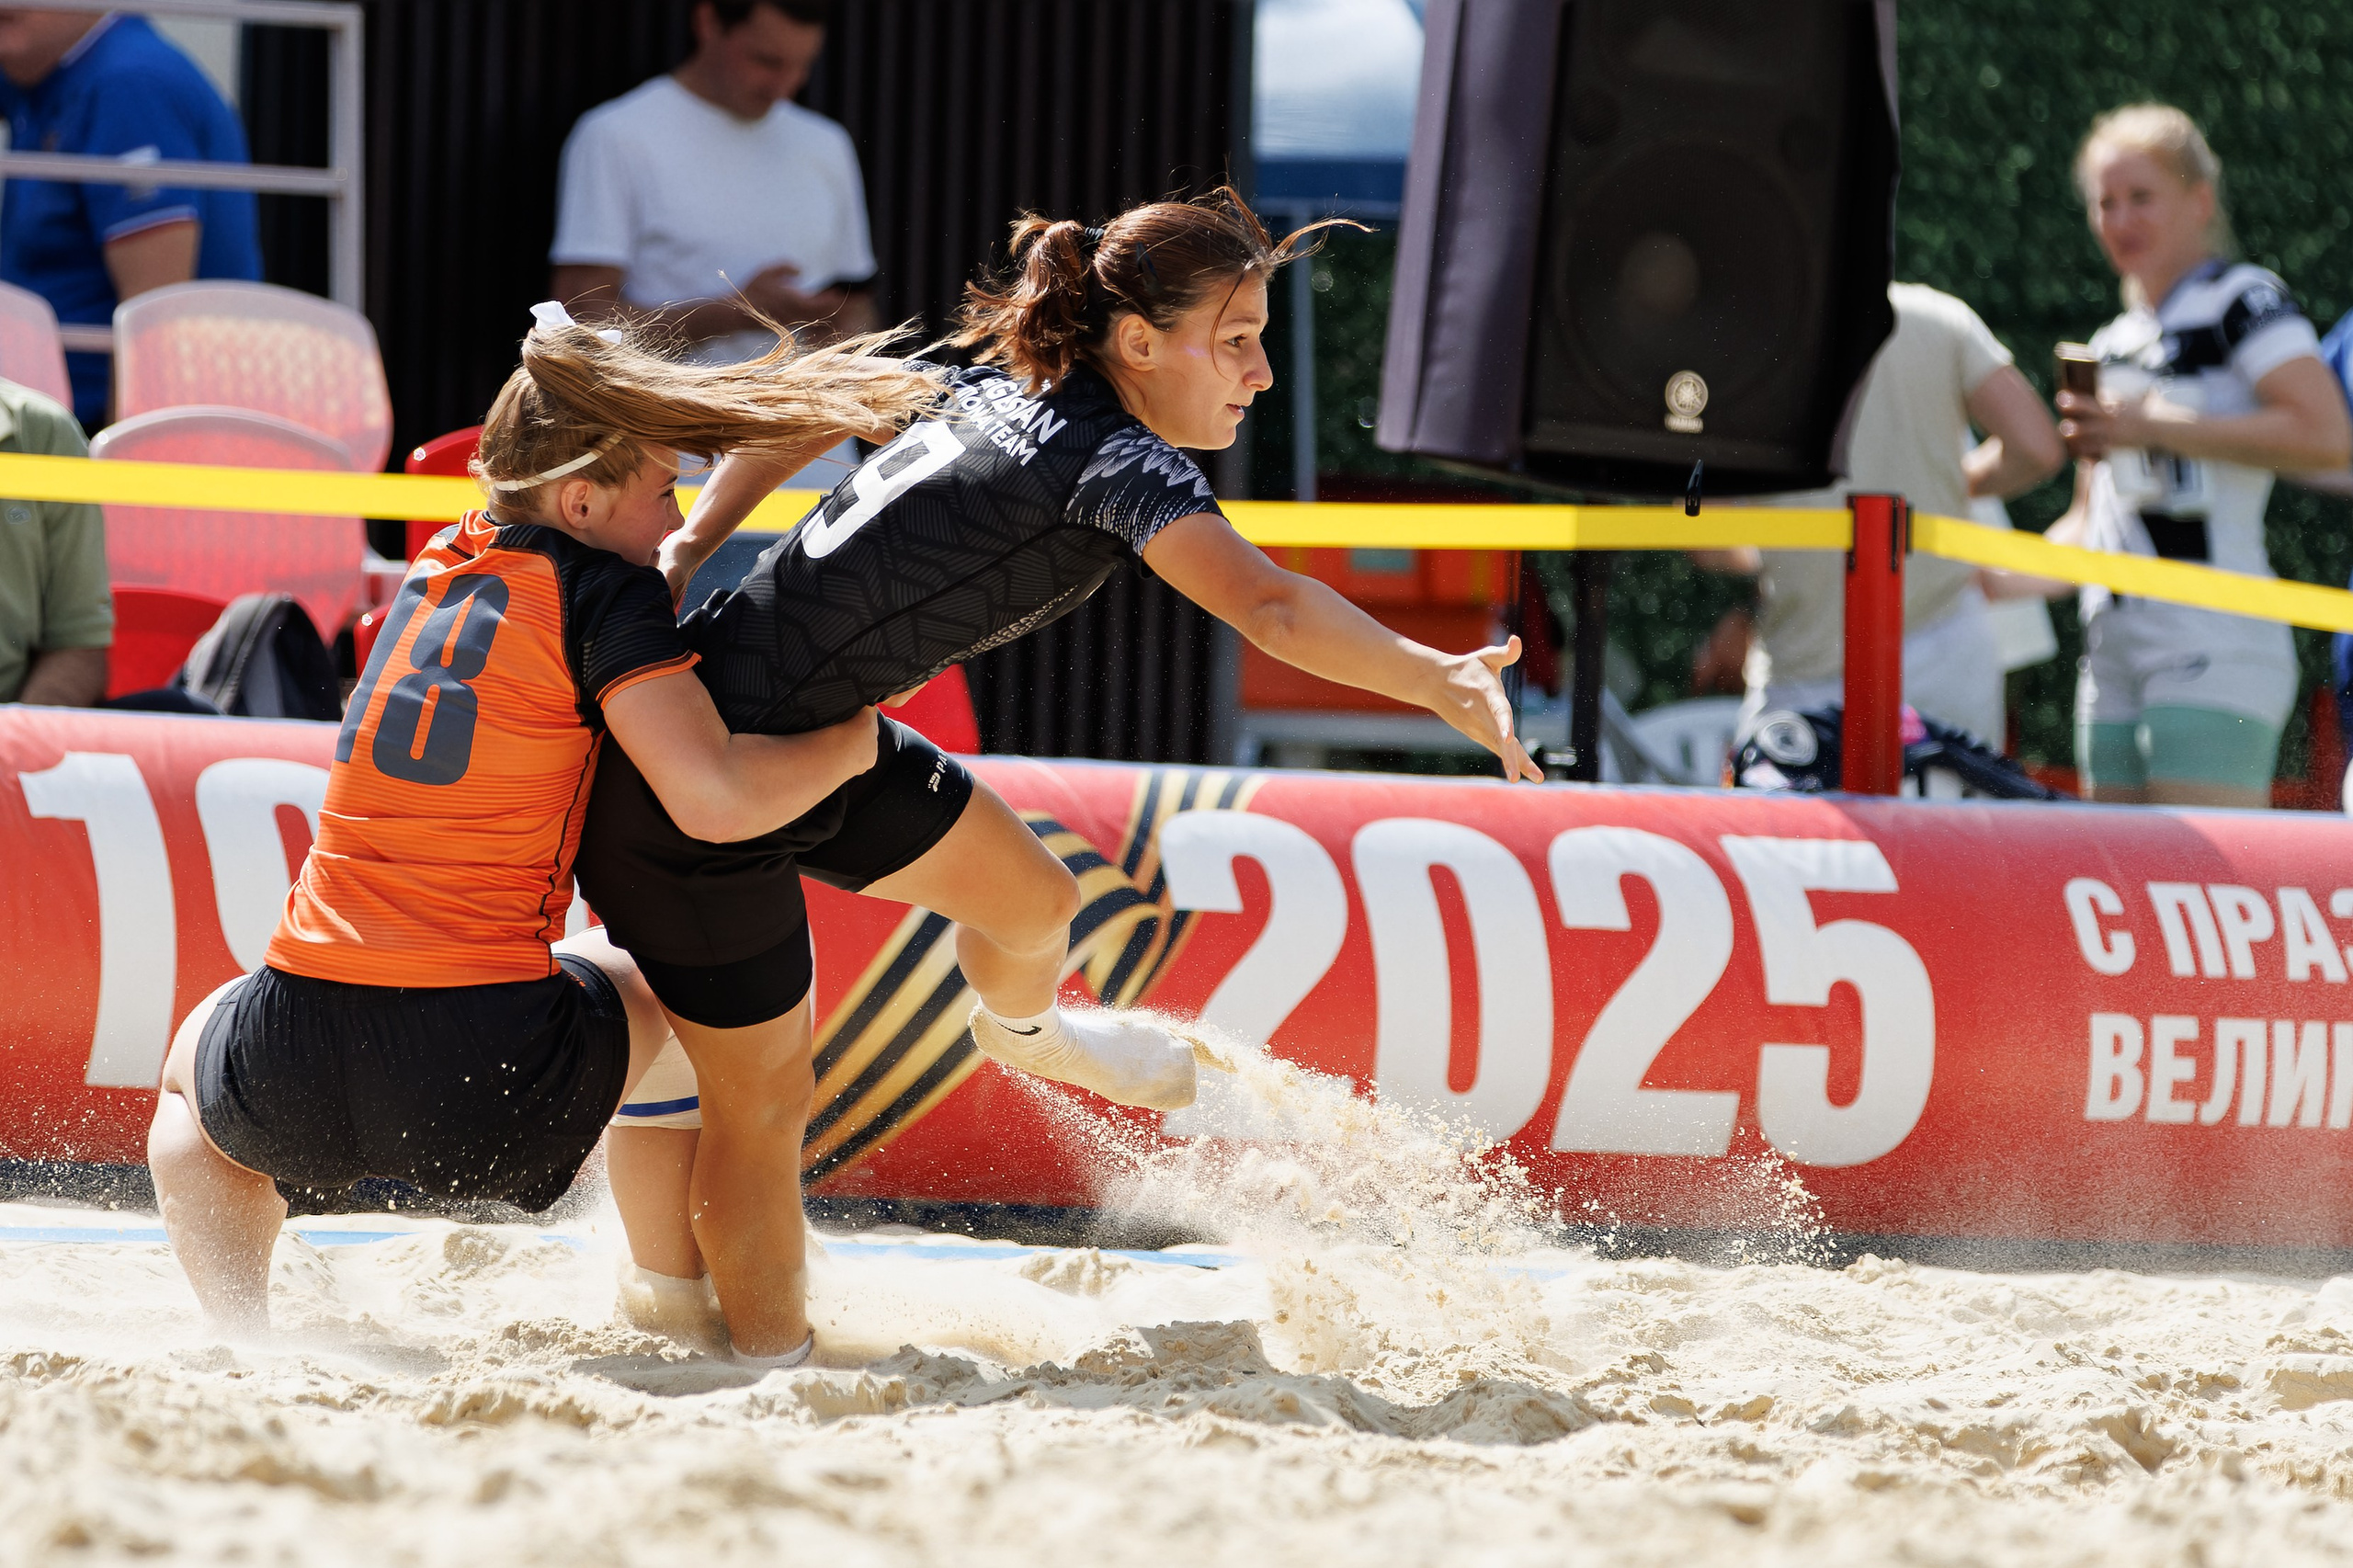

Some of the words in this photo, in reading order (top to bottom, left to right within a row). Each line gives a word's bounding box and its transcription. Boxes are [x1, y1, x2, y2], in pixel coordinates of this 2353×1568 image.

[801, 420, 967, 559] 9
[985, 419, 1039, 467] TEAM
[334, 565, 510, 786] 18
[1160, 810, 1936, 1167] 2025
[2063, 877, 2137, 977] С
